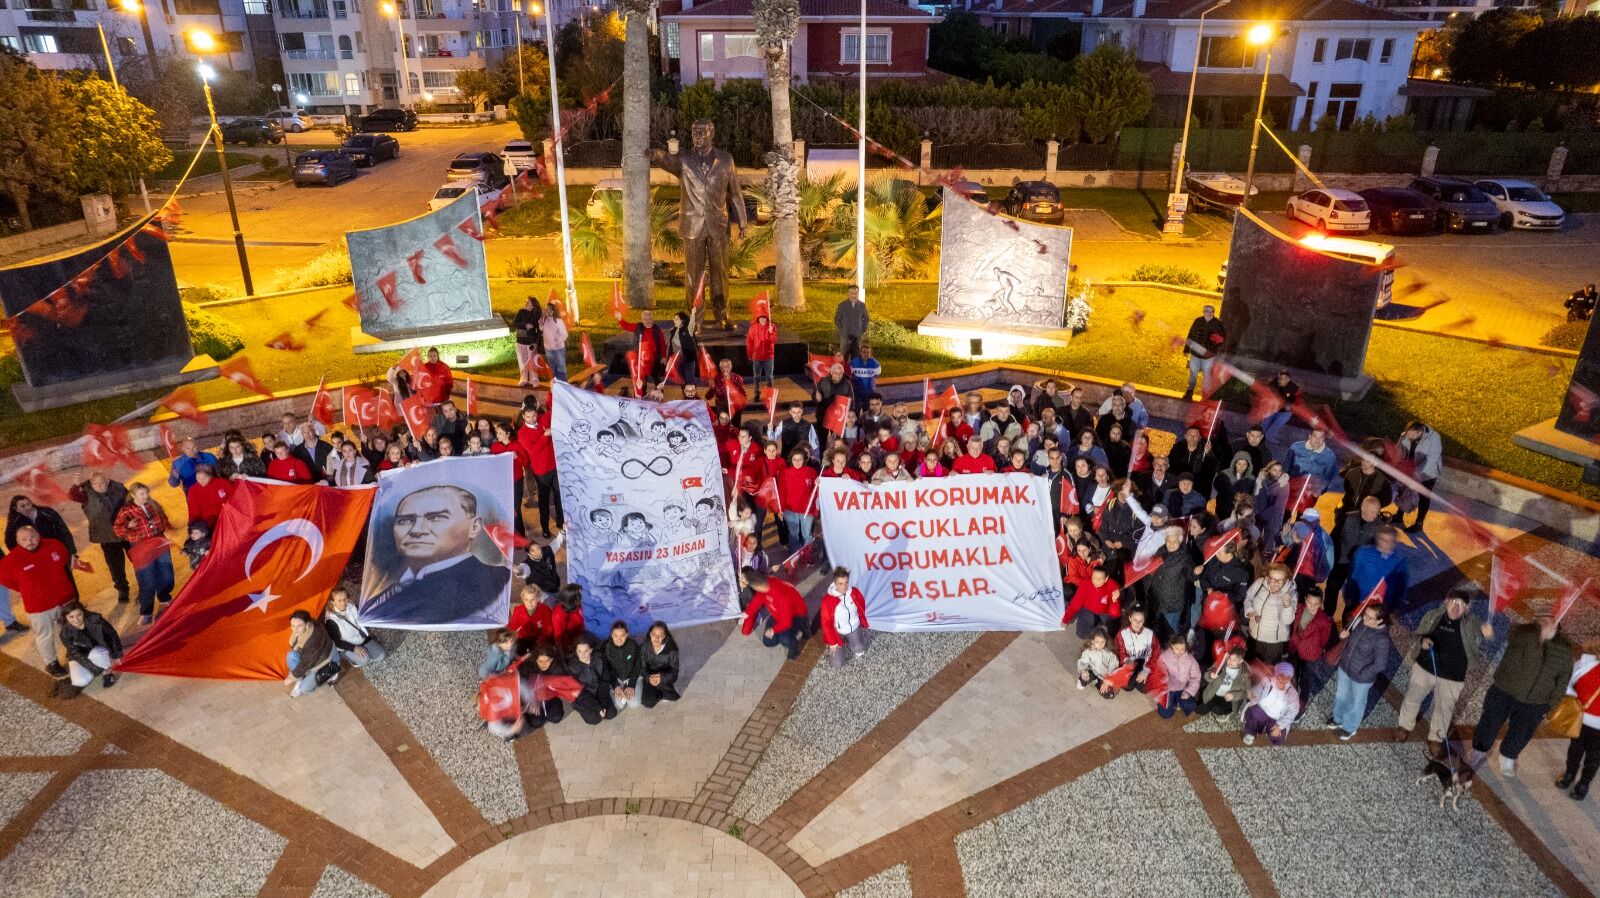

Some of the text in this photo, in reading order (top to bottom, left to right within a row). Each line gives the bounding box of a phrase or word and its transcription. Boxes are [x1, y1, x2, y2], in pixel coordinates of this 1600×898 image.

[834, 485, 1036, 511] VATANI KORUMAK,
[865, 516, 1006, 543] ÇOCUKLARI
[605, 539, 706, 563] YAŞASIN 23 NİSAN
[864, 545, 1013, 571] KORUMAKLA
[891, 578, 996, 601] BAŞLAR.
